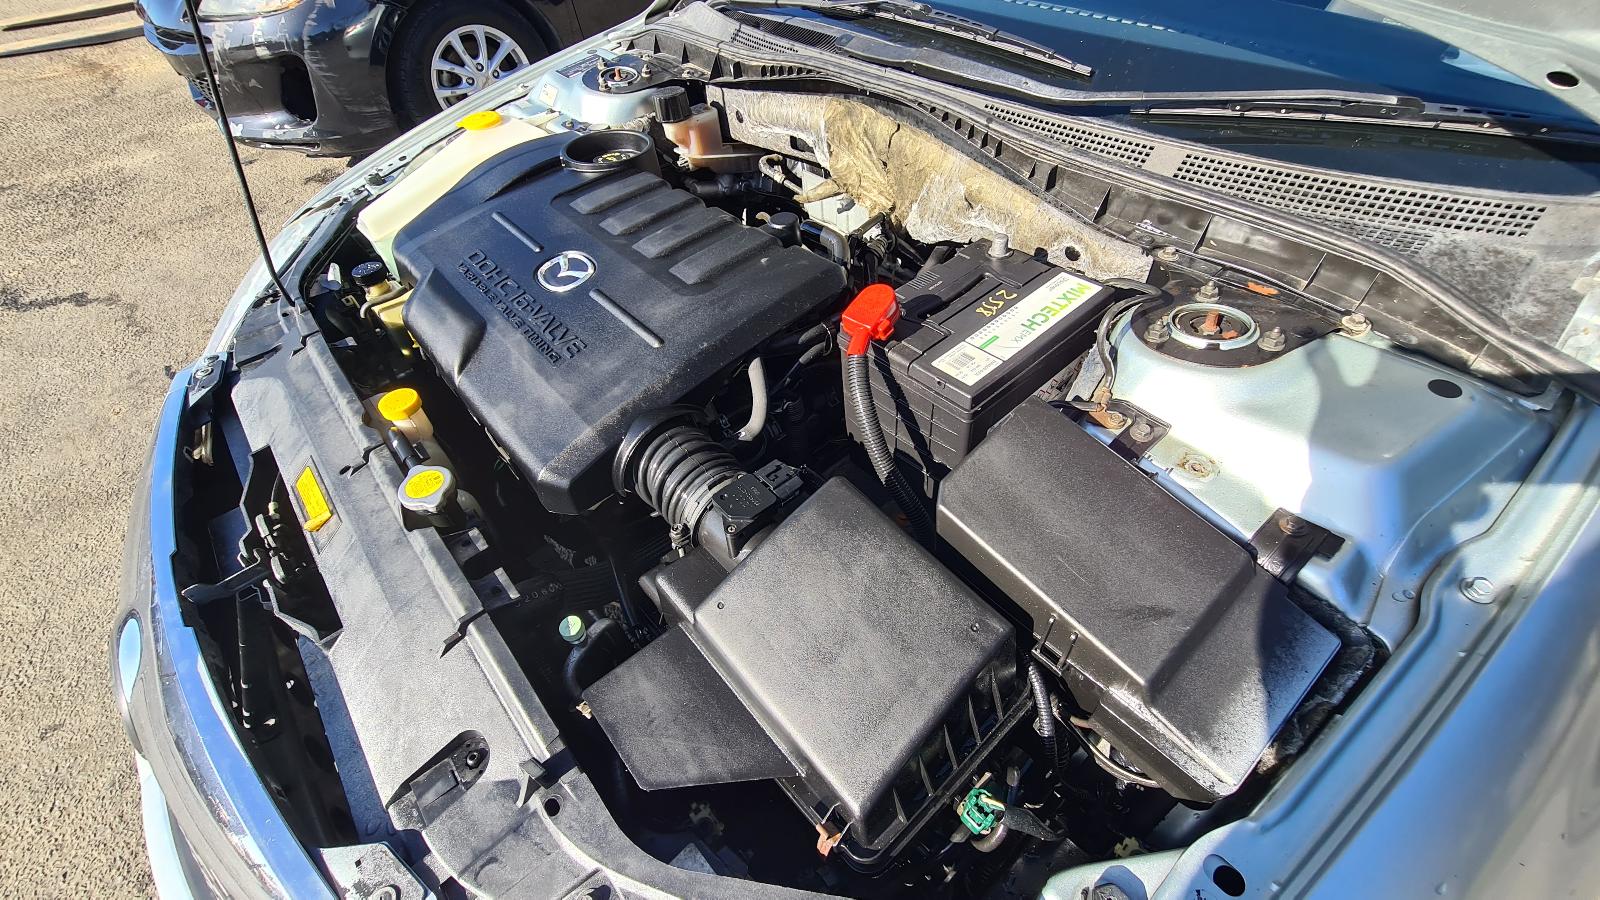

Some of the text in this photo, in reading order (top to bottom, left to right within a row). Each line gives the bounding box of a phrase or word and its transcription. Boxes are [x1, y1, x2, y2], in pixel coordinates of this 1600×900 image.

[467, 249, 588, 360] DOHC 16-VALVE
[495, 299, 524, 330] VALVE
[522, 324, 562, 364] TIMING
[1021, 281, 1092, 332] MIXTECH
